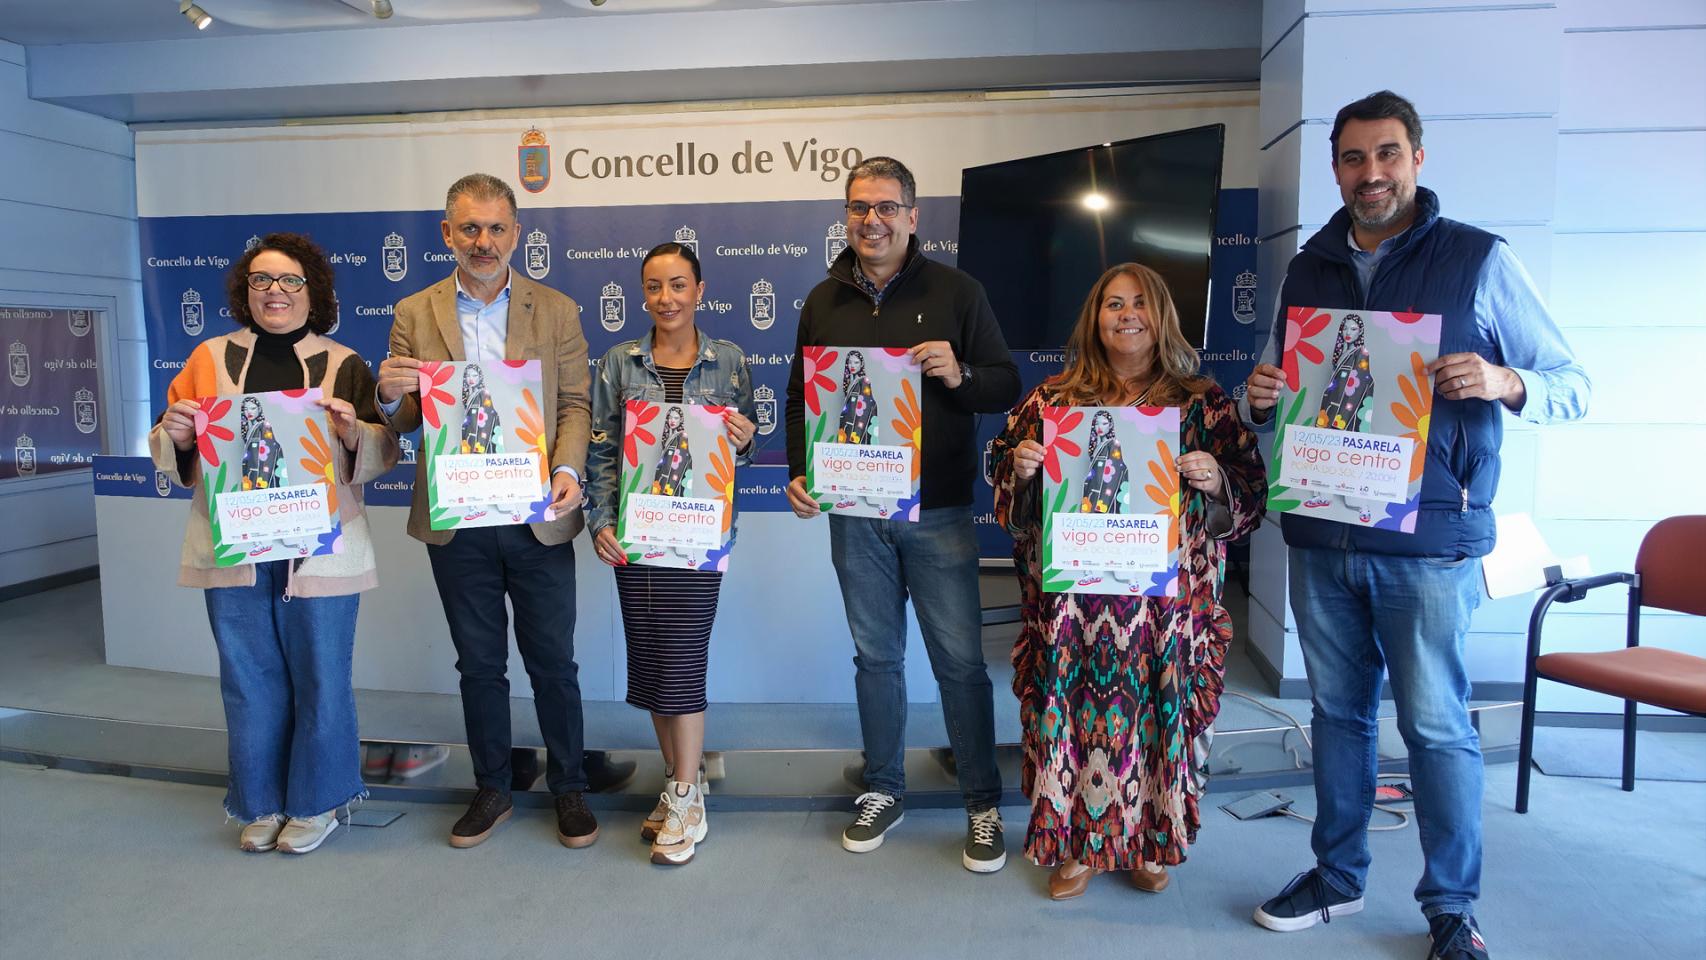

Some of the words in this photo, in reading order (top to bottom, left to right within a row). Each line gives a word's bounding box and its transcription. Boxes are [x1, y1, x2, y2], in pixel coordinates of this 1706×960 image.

[564, 142, 718, 179] Concello
[731, 140, 774, 174] de
[783, 138, 863, 183] Vigo
[567, 247, 614, 259] Concello
[617, 247, 630, 259] de
[632, 246, 649, 261] Vig
[716, 244, 765, 257] Concello
[767, 244, 781, 256] de
[783, 243, 808, 258] Vigo
[923, 240, 937, 252] de
[940, 240, 958, 254] Vig
[147, 256, 192, 267] Concello
[194, 255, 206, 266] de
[207, 255, 230, 269] Vigo
[331, 253, 344, 264] de
[344, 253, 367, 267] Vigo
[424, 252, 457, 262] Conce
[356, 305, 398, 316] Concell
[708, 300, 732, 314] Vigo
[154, 359, 187, 369] Conce
[769, 354, 782, 365] de
[1293, 431, 1341, 447] 12/05/23
[1342, 436, 1401, 454] PASARELA
[860, 449, 904, 460] PASARELA
[1293, 443, 1331, 464] vigo
[1337, 453, 1401, 471] centro
[486, 457, 532, 467] PASARELA
[822, 456, 852, 473] vigo
[856, 460, 905, 474] centro
[124, 472, 132, 481] de
[446, 467, 480, 484] vigo
[484, 466, 534, 480] centro
[374, 481, 409, 490] Concello
[737, 485, 765, 495] ncello
[767, 485, 779, 495] de
[269, 488, 320, 502] PASARELA
[227, 504, 262, 521] vigo
[268, 500, 321, 515] centro
[671, 500, 716, 513] PASARELA
[635, 507, 664, 523] vigo
[668, 512, 716, 525] centro
[1106, 519, 1160, 530] PASARELA
[1062, 528, 1098, 545] vigo
[1103, 530, 1160, 544] centro
